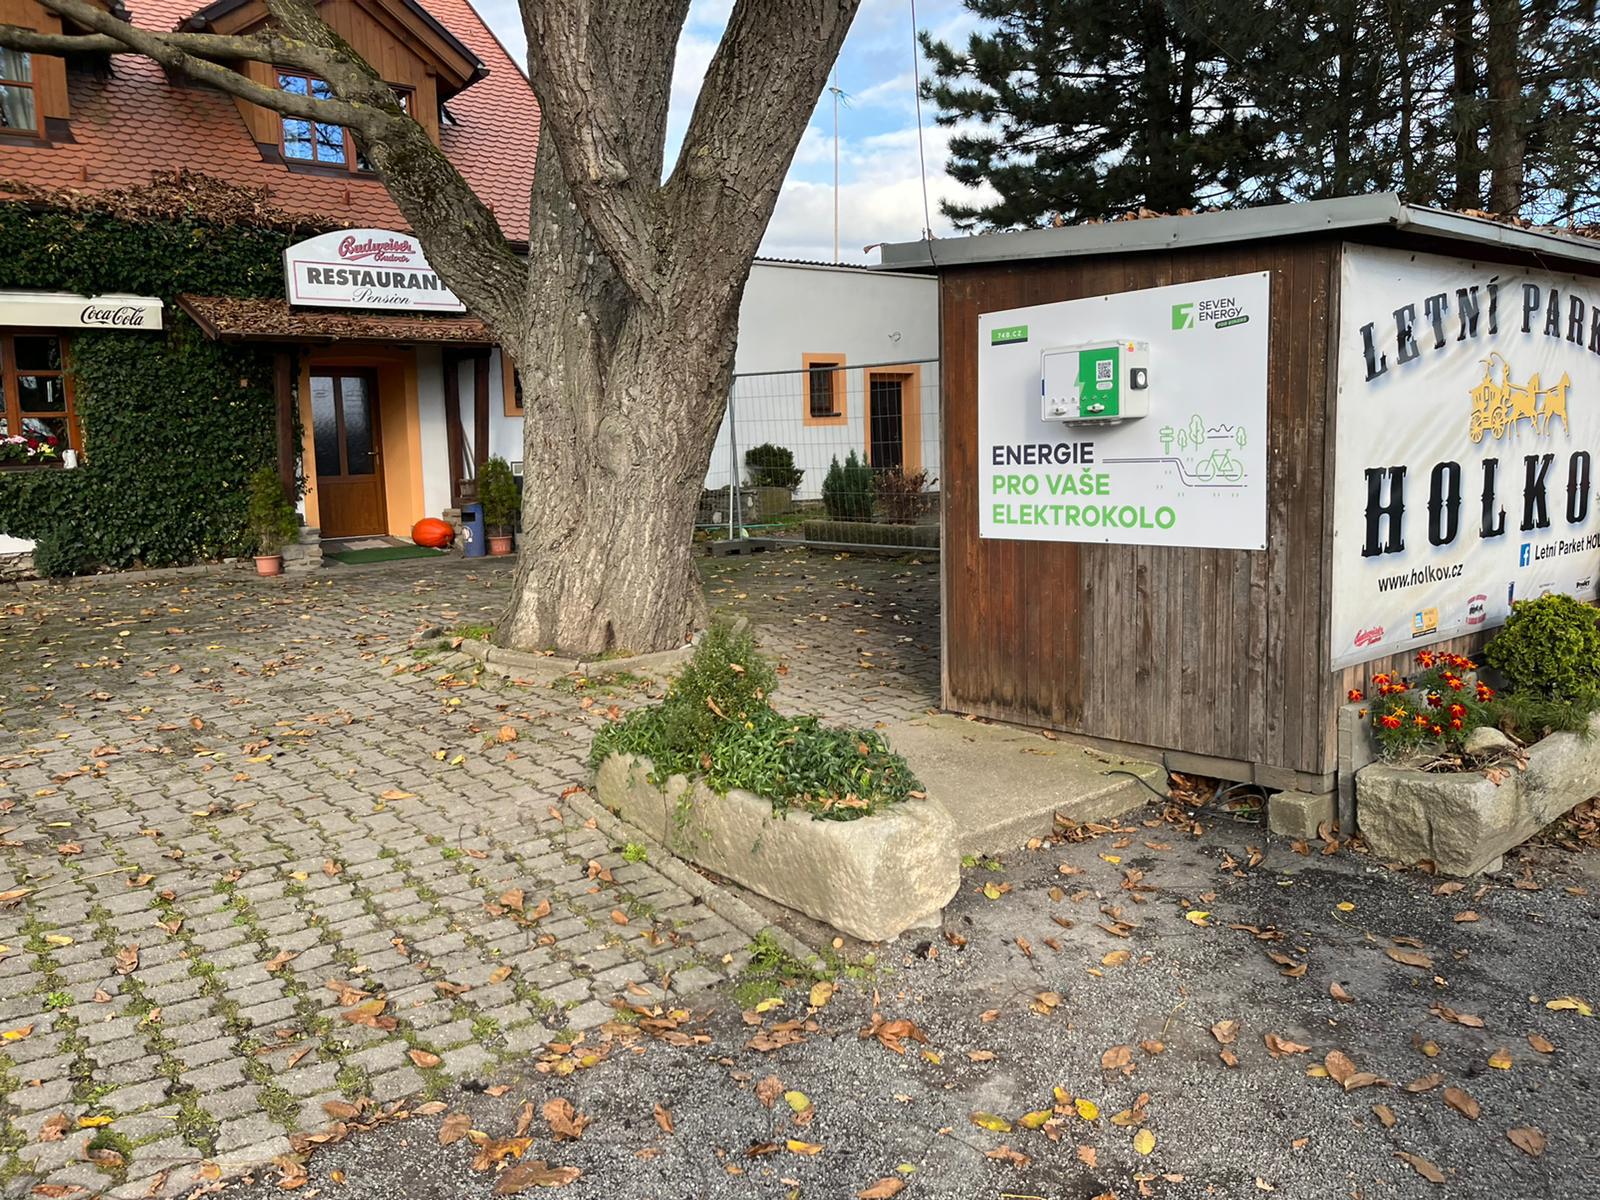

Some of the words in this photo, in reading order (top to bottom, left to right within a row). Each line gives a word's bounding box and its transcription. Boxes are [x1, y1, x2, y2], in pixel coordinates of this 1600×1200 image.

[338, 235, 415, 260] Budweiser
[352, 287, 411, 304] Pension
[1199, 297, 1235, 310] SEVEN
[1199, 307, 1242, 321] ENERGY
[1359, 275, 1499, 382] LETNÍ
[992, 442, 1094, 465] ENERGIE
[992, 474, 1039, 495] PRO
[1046, 468, 1110, 495] VAŠE
[992, 504, 1176, 529] ELEKTROKOLO
[1535, 541, 1557, 560] Letní
[1558, 538, 1584, 556] Parket
[1378, 564, 1463, 592] www.holkov.cz
